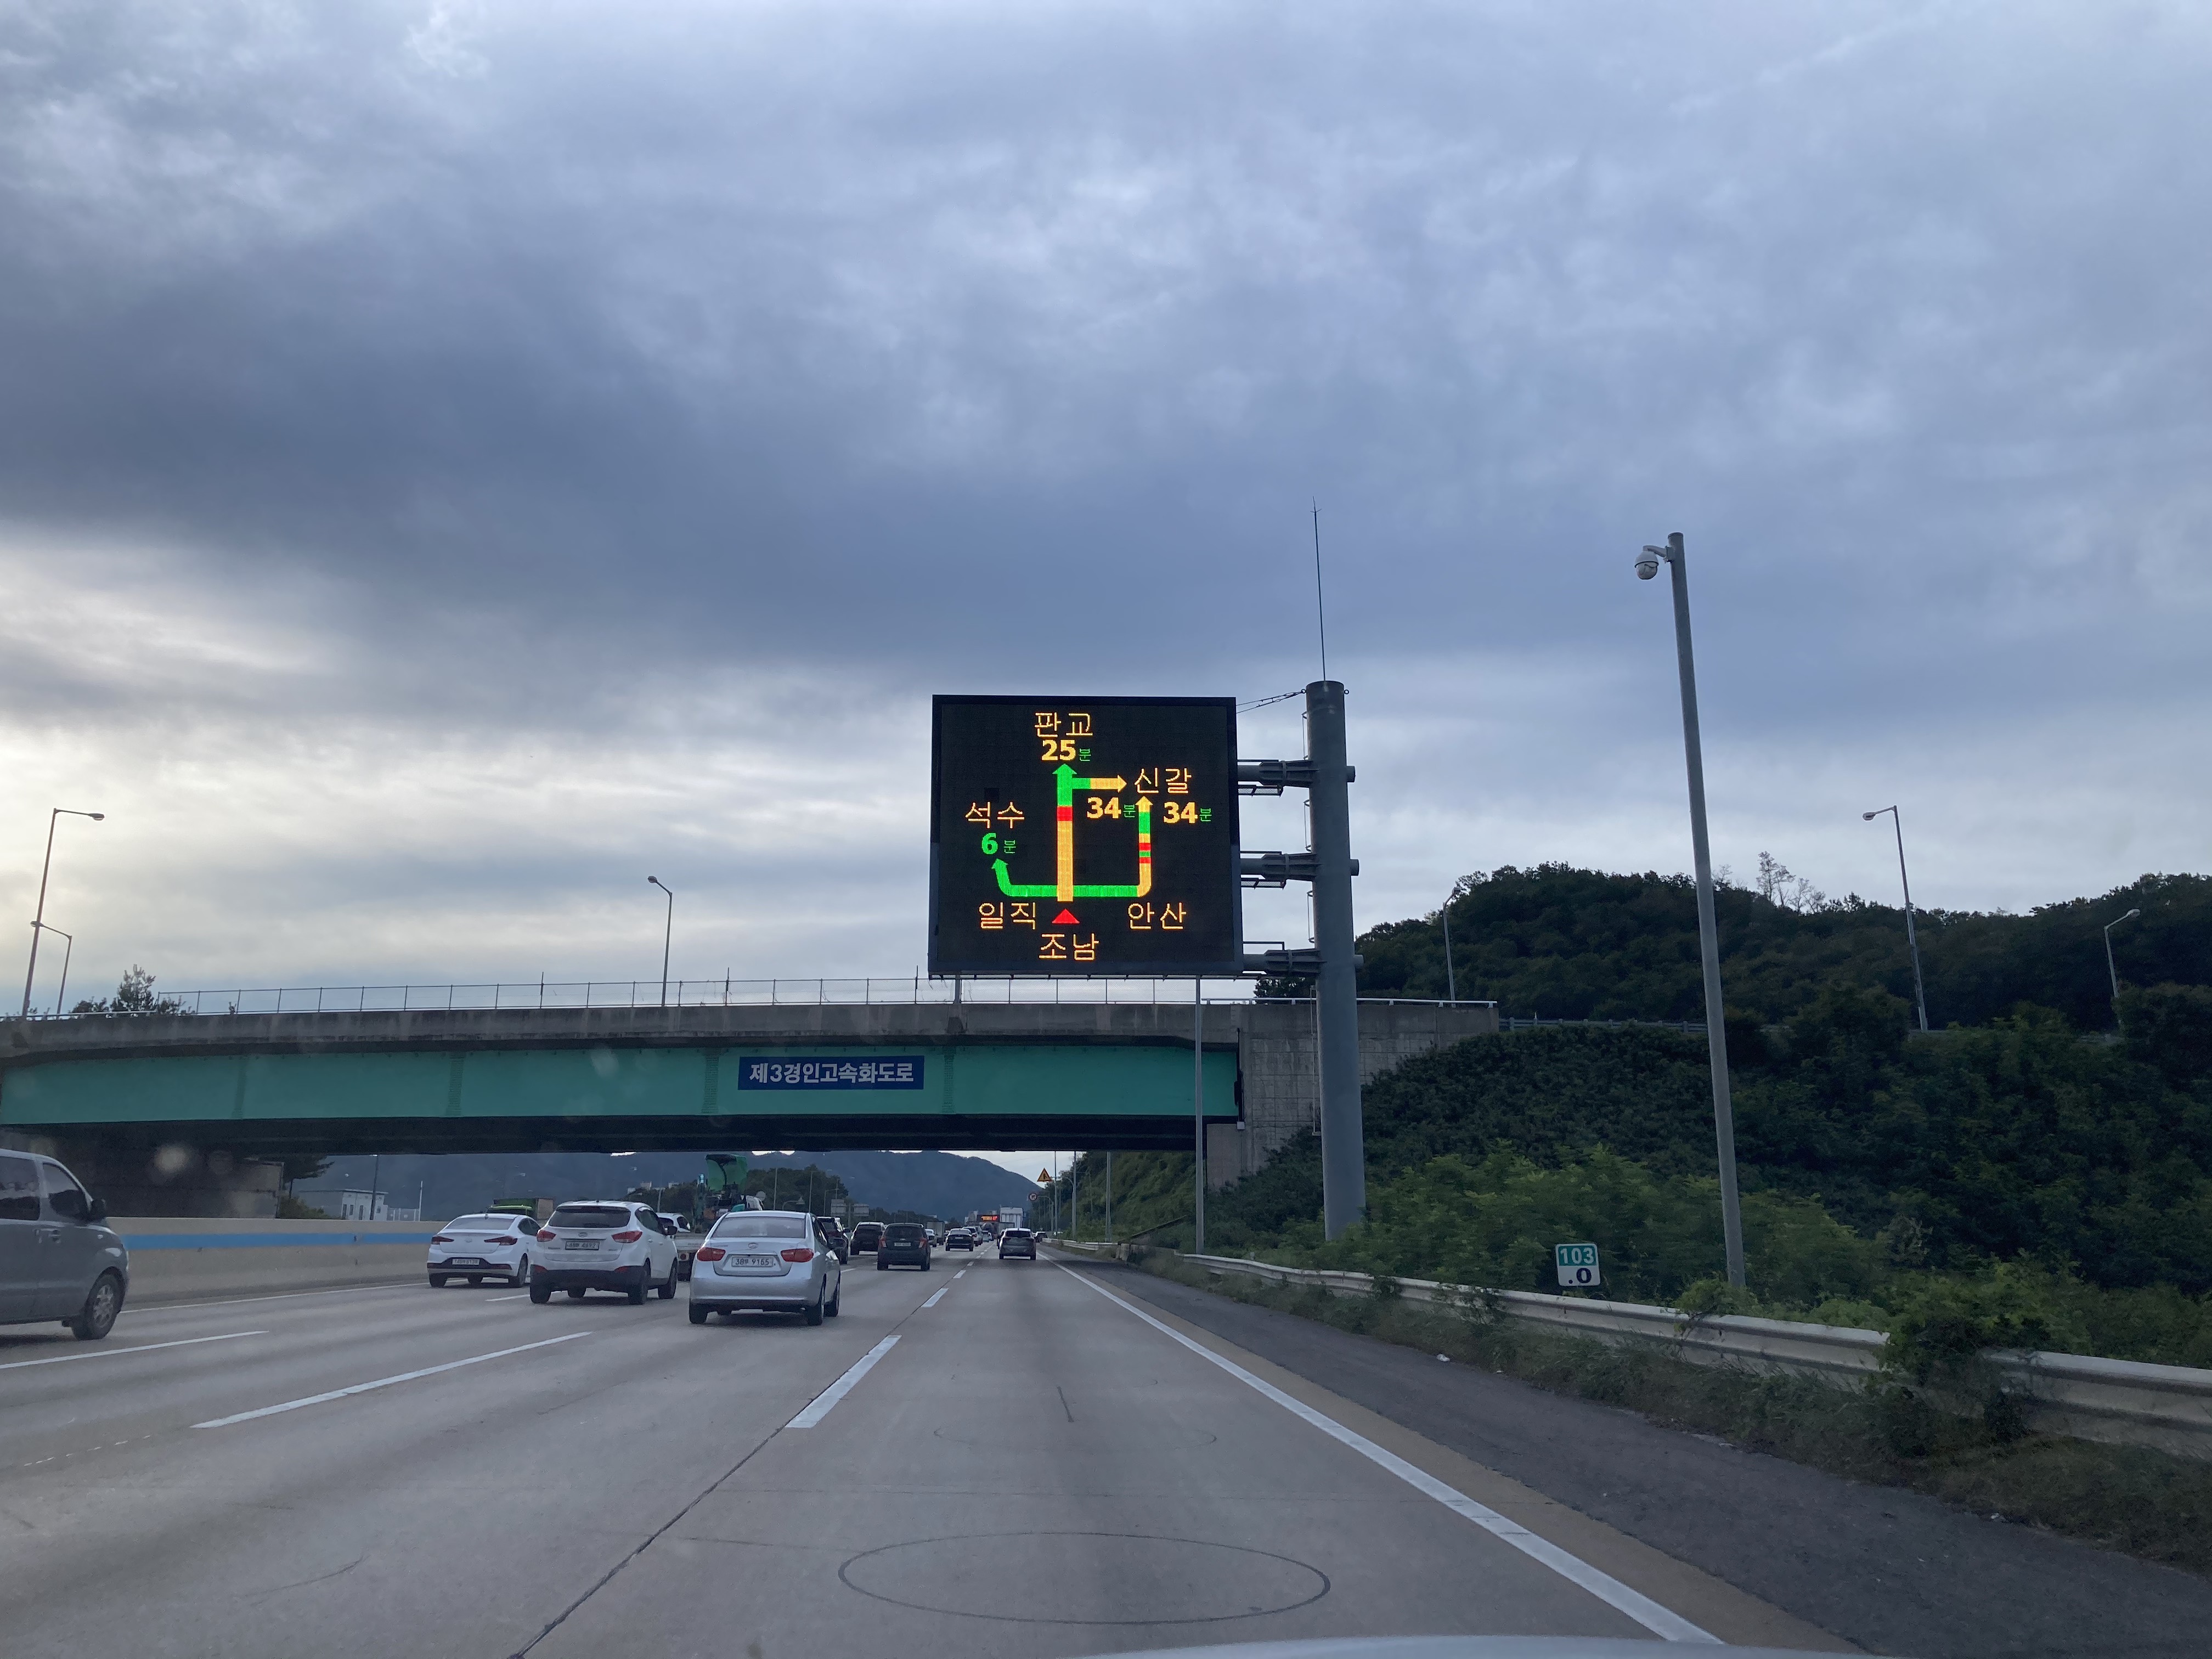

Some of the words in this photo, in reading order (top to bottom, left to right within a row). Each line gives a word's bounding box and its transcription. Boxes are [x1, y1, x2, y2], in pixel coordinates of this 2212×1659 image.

[1035, 712, 1093, 737] 판교
[1135, 768, 1192, 793] 신갈
[966, 802, 1024, 828] 석수
[979, 902, 1036, 929] 일직
[1128, 902, 1186, 929] 안산
[1039, 933, 1099, 961] 조남
[749, 1063, 914, 1084] 제3경인고속화도로
[1560, 1247, 1594, 1264] 103
